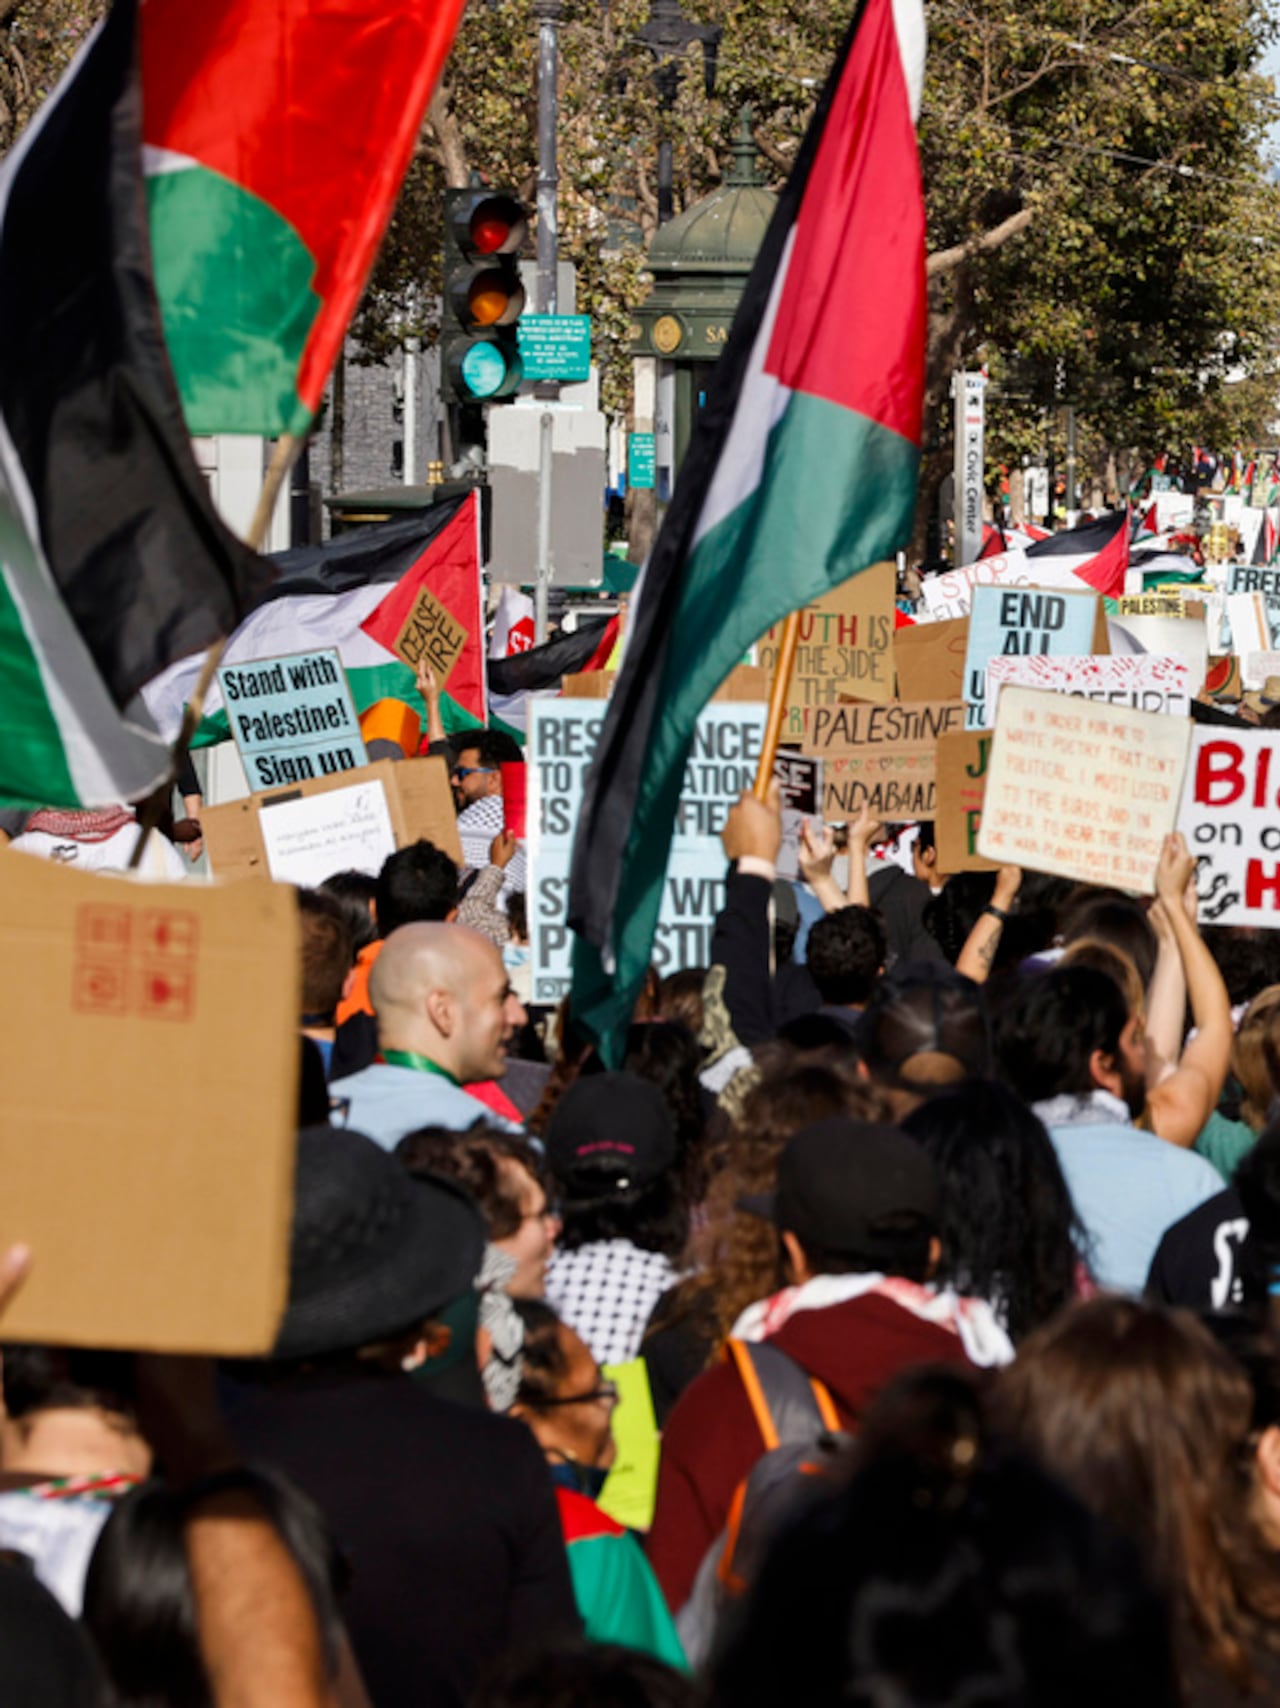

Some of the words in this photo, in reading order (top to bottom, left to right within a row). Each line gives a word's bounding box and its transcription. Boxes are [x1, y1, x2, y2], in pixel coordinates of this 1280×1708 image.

[966, 450, 979, 482] Civic
[966, 486, 979, 533] Center
[399, 592, 442, 667] CEASE
[1000, 592, 1066, 631] END
[422, 622, 463, 675] IRE
[868, 614, 891, 651] IS
[222, 662, 288, 702] Stand
[288, 654, 339, 692] with
[797, 645, 830, 676] THE
[832, 647, 885, 684] SIDE
[237, 697, 350, 743] Palestine!
[537, 716, 763, 761] RESNCE
[255, 752, 317, 787] Sign
[538, 760, 573, 794] TO
[540, 797, 571, 836] IS
[1193, 822, 1243, 847] on
